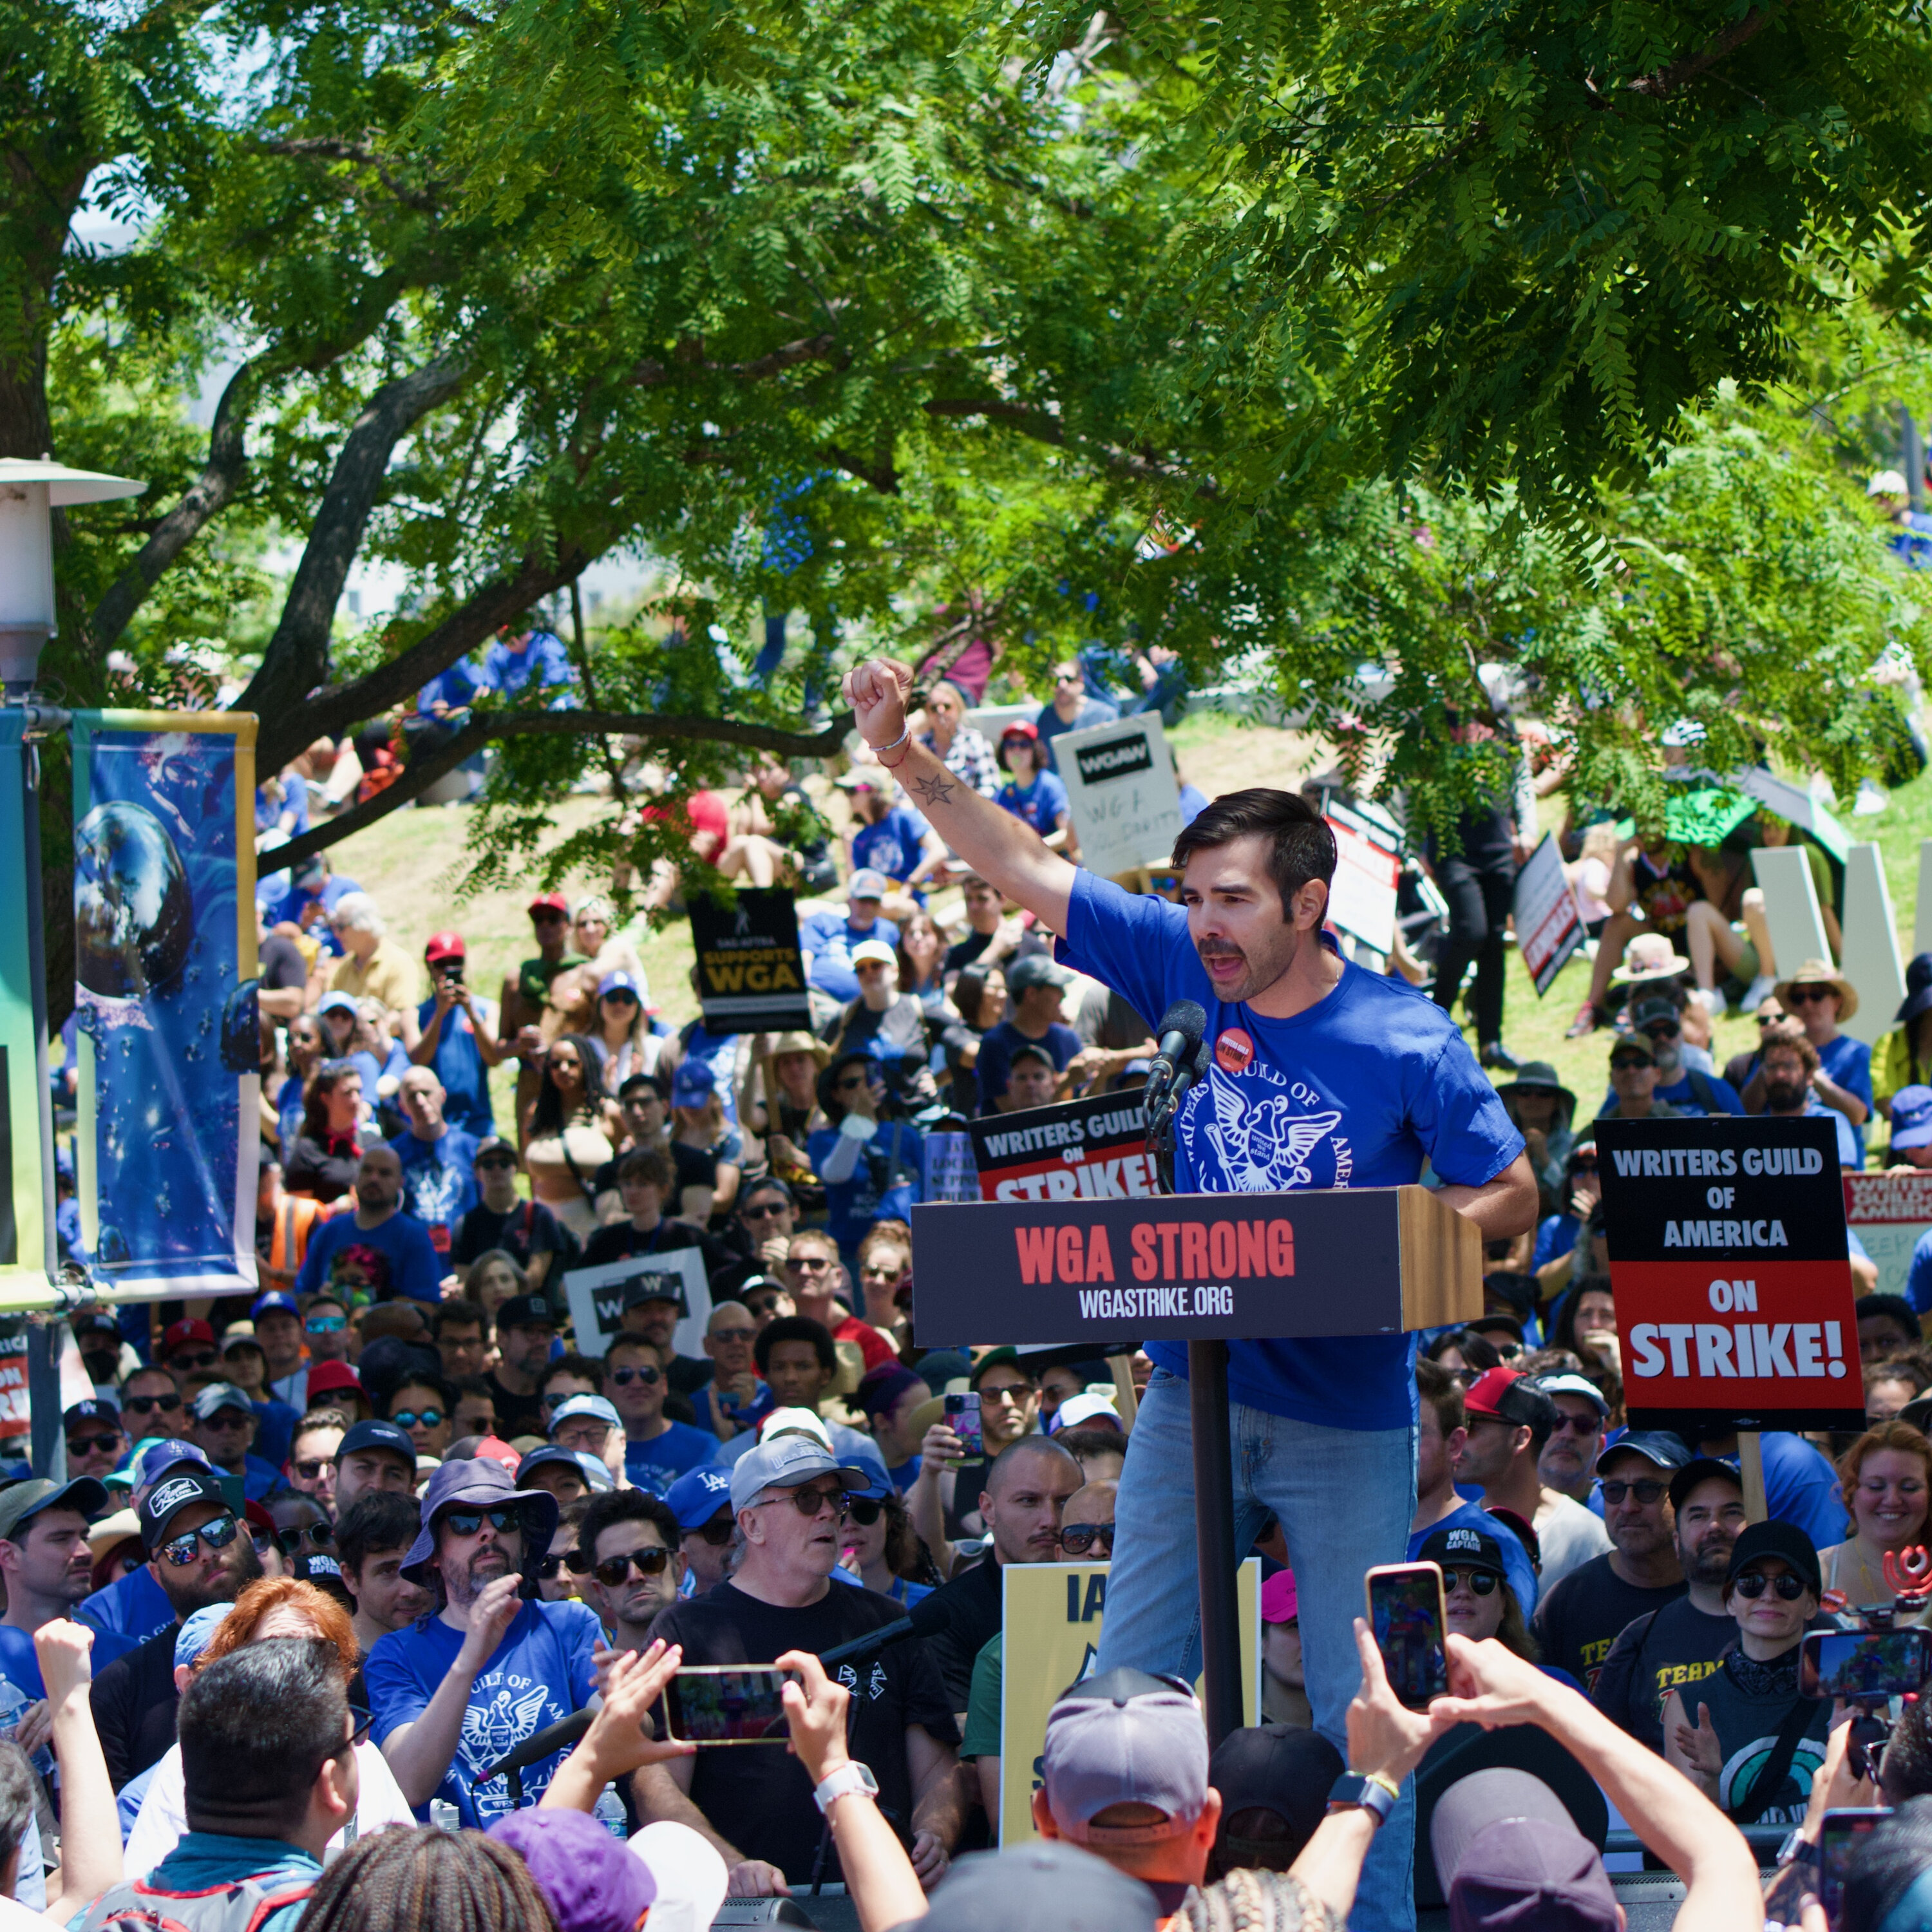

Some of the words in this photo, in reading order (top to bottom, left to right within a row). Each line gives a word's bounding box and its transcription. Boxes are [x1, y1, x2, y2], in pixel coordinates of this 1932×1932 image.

[706, 963, 800, 992] WGA
[1290, 1082, 1320, 1107] OF
[983, 1119, 1085, 1158] WRITERS
[1062, 1146, 1086, 1164] ON
[1612, 1149, 1738, 1177] WRITERS
[1743, 1148, 1823, 1176] GUILD
[1707, 1186, 1735, 1209] OF
[1663, 1220, 1789, 1247] AMERICA
[1014, 1225, 1115, 1285] WGA
[1131, 1218, 1295, 1282] STRONG
[1079, 1285, 1234, 1319] WGASTRIKE.ORG
[1709, 1279, 1759, 1313] ON
[1629, 1320, 1847, 1379] STRIKE!
[697, 1472, 729, 1492] LA
[1446, 1540, 1481, 1553] CAPTAIN
[1448, 1529, 1481, 1543] WGA
[308, 1555, 339, 1567] WGA
[507, 1674, 532, 1690] OF
[491, 1800, 521, 1809] WES
